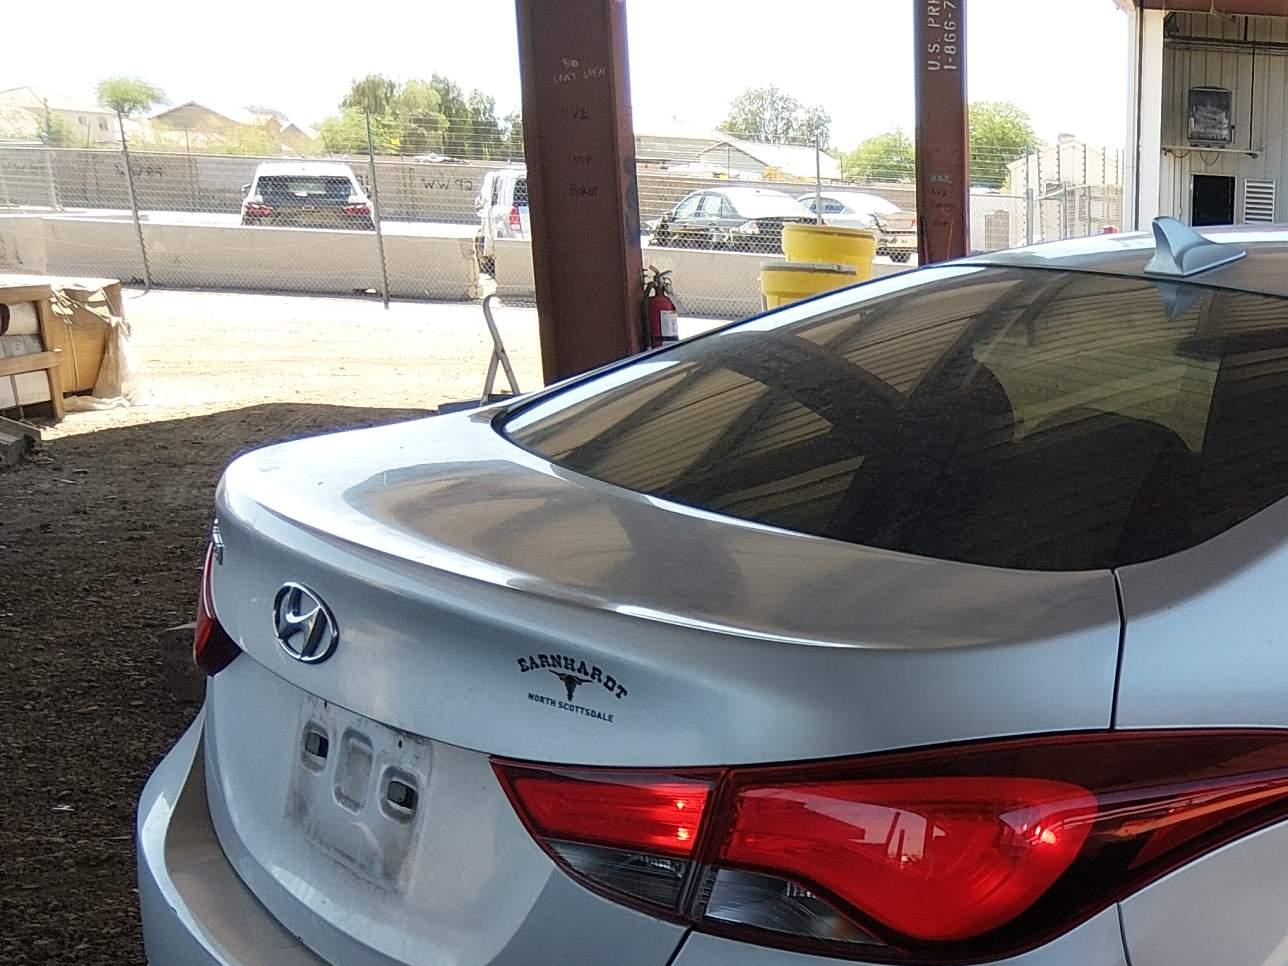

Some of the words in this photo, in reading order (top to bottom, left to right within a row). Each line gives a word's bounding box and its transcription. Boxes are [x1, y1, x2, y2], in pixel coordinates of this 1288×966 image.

[927, 38, 941, 71] U.S.
[517, 654, 628, 699] EARNHARDT
[528, 692, 556, 707] NORTH
[558, 700, 615, 723] SCOTTSDALE
